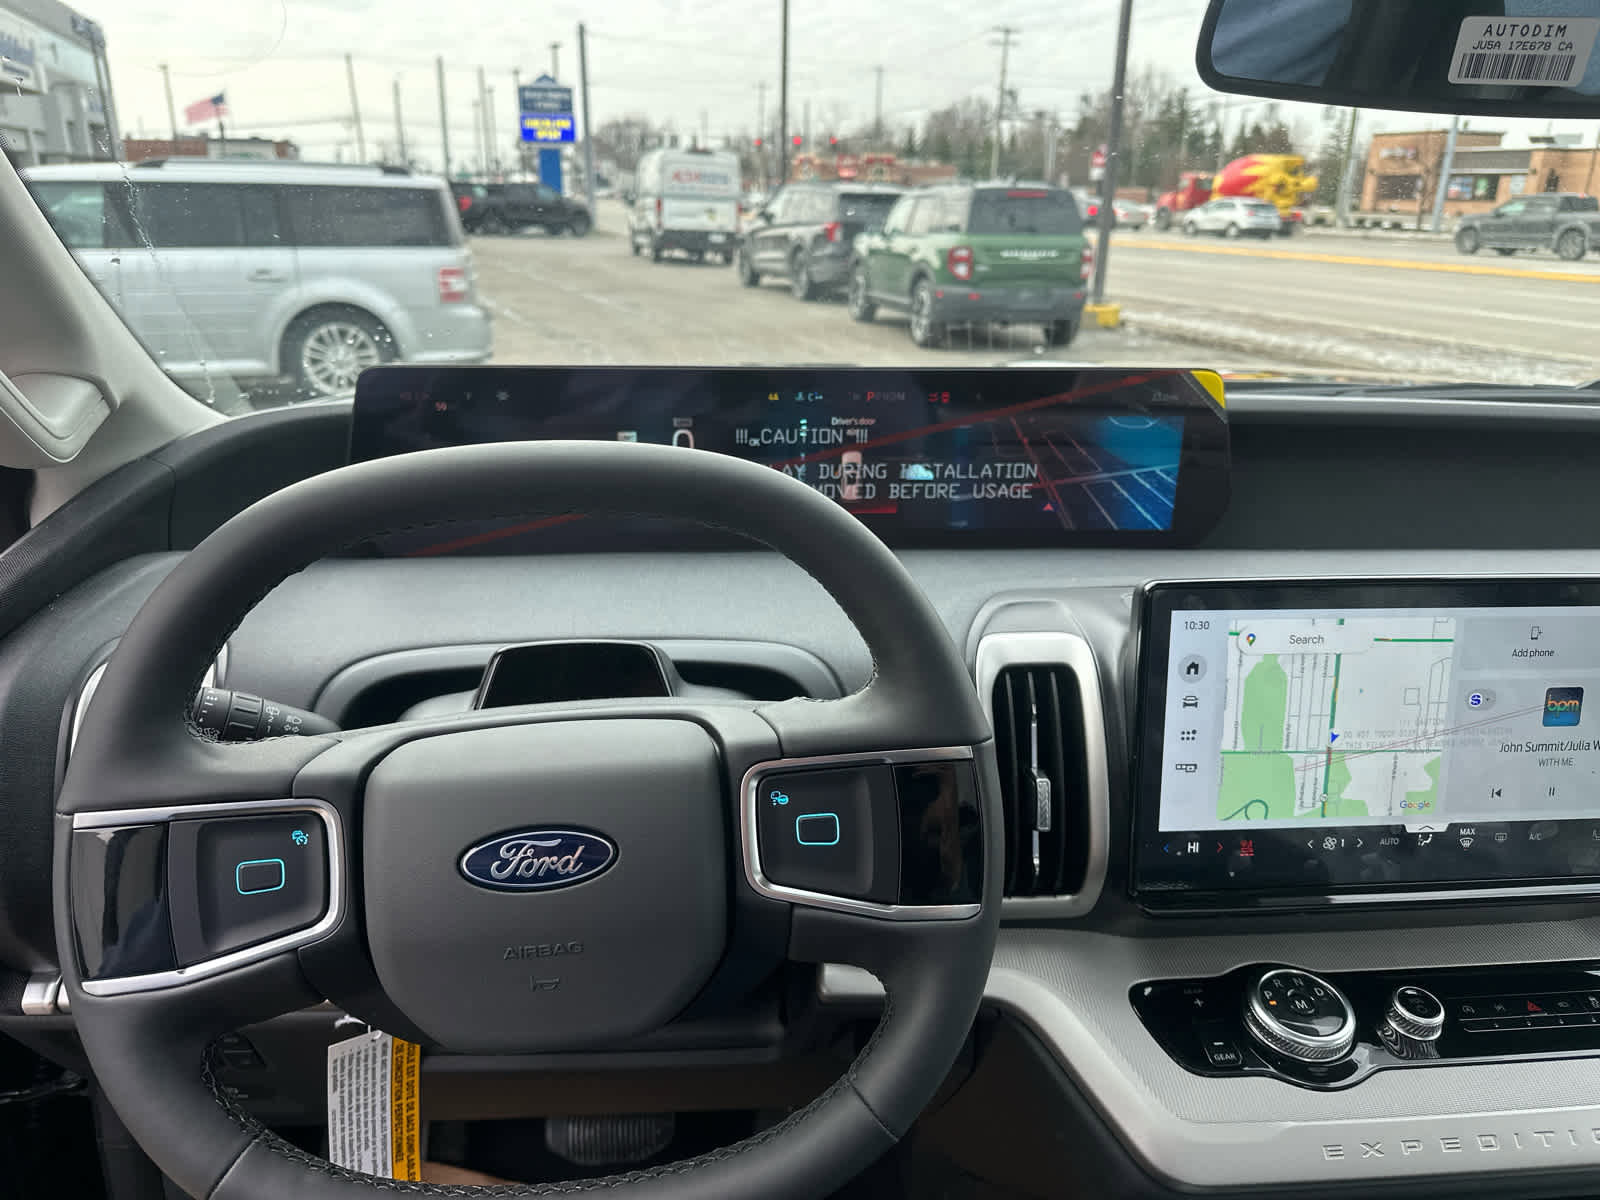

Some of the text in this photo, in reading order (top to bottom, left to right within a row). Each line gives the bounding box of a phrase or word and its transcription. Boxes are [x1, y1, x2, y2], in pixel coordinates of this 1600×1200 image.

[1483, 23, 1568, 38] AUTODIM
[1557, 42, 1574, 52] CA
[760, 427, 844, 445] CAUTION
[819, 463, 888, 480] DURING
[900, 463, 1038, 480] ITALLATION
[889, 483, 961, 500] BEFORE
[972, 483, 1034, 500] USAGE
[1183, 620, 1211, 632] 10:30
[1288, 633, 1325, 646] Search
[1511, 647, 1556, 660] Add phone
[1499, 742, 1524, 753] John
[1524, 739, 1591, 753] Summit/Julia
[1537, 758, 1575, 768] WITH ME
[1399, 800, 1431, 811] Google
[1459, 828, 1476, 836] MAX
[1528, 833, 1542, 842] A/C
[1379, 837, 1400, 846] AUTO
[1187, 842, 1200, 854] HI
[490, 838, 585, 880] Ford
[503, 940, 585, 961] AIRBAG
[1273, 979, 1284, 988] R
[1292, 977, 1305, 986] N
[1263, 990, 1273, 1000] P
[1313, 987, 1324, 997] D
[1295, 999, 1309, 1009] M
[1214, 1052, 1237, 1062] GEAR
